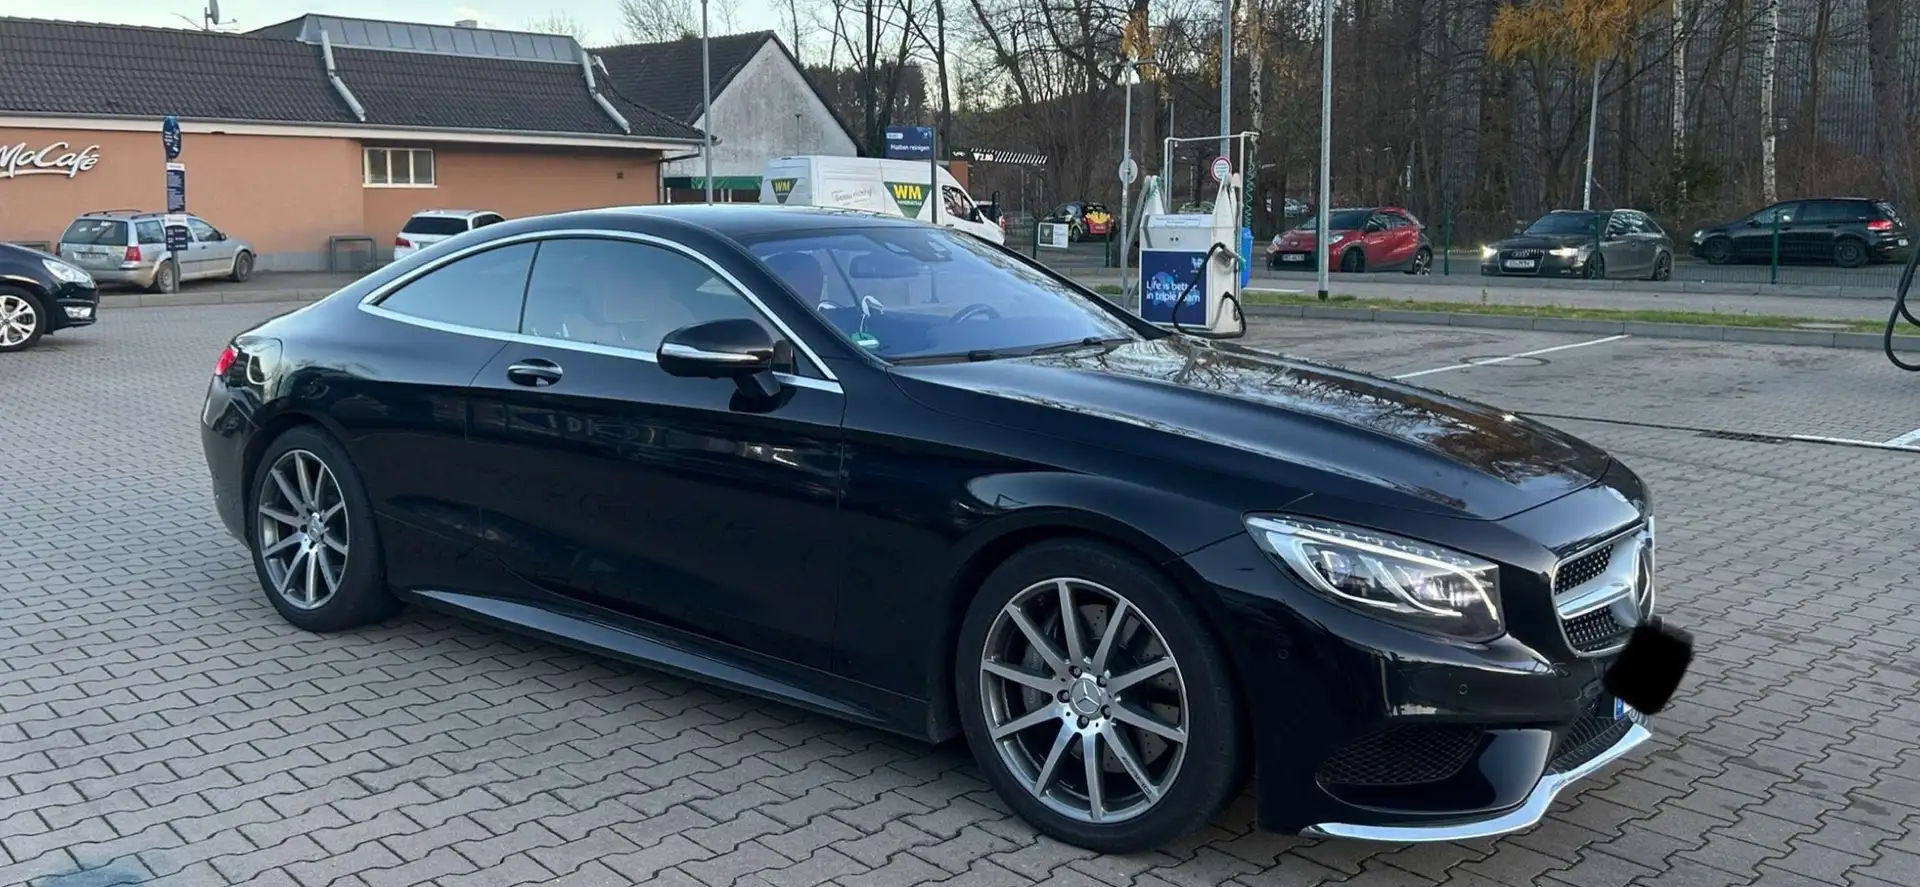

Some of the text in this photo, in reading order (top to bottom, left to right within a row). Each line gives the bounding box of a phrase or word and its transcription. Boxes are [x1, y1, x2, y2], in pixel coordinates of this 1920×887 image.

[890, 143, 930, 152] Matten reinigen
[775, 180, 790, 193] WM
[893, 184, 922, 200] WM
[1146, 280, 1198, 291] Life is bettr
[1146, 291, 1154, 300] in
[1155, 291, 1177, 302] triple
